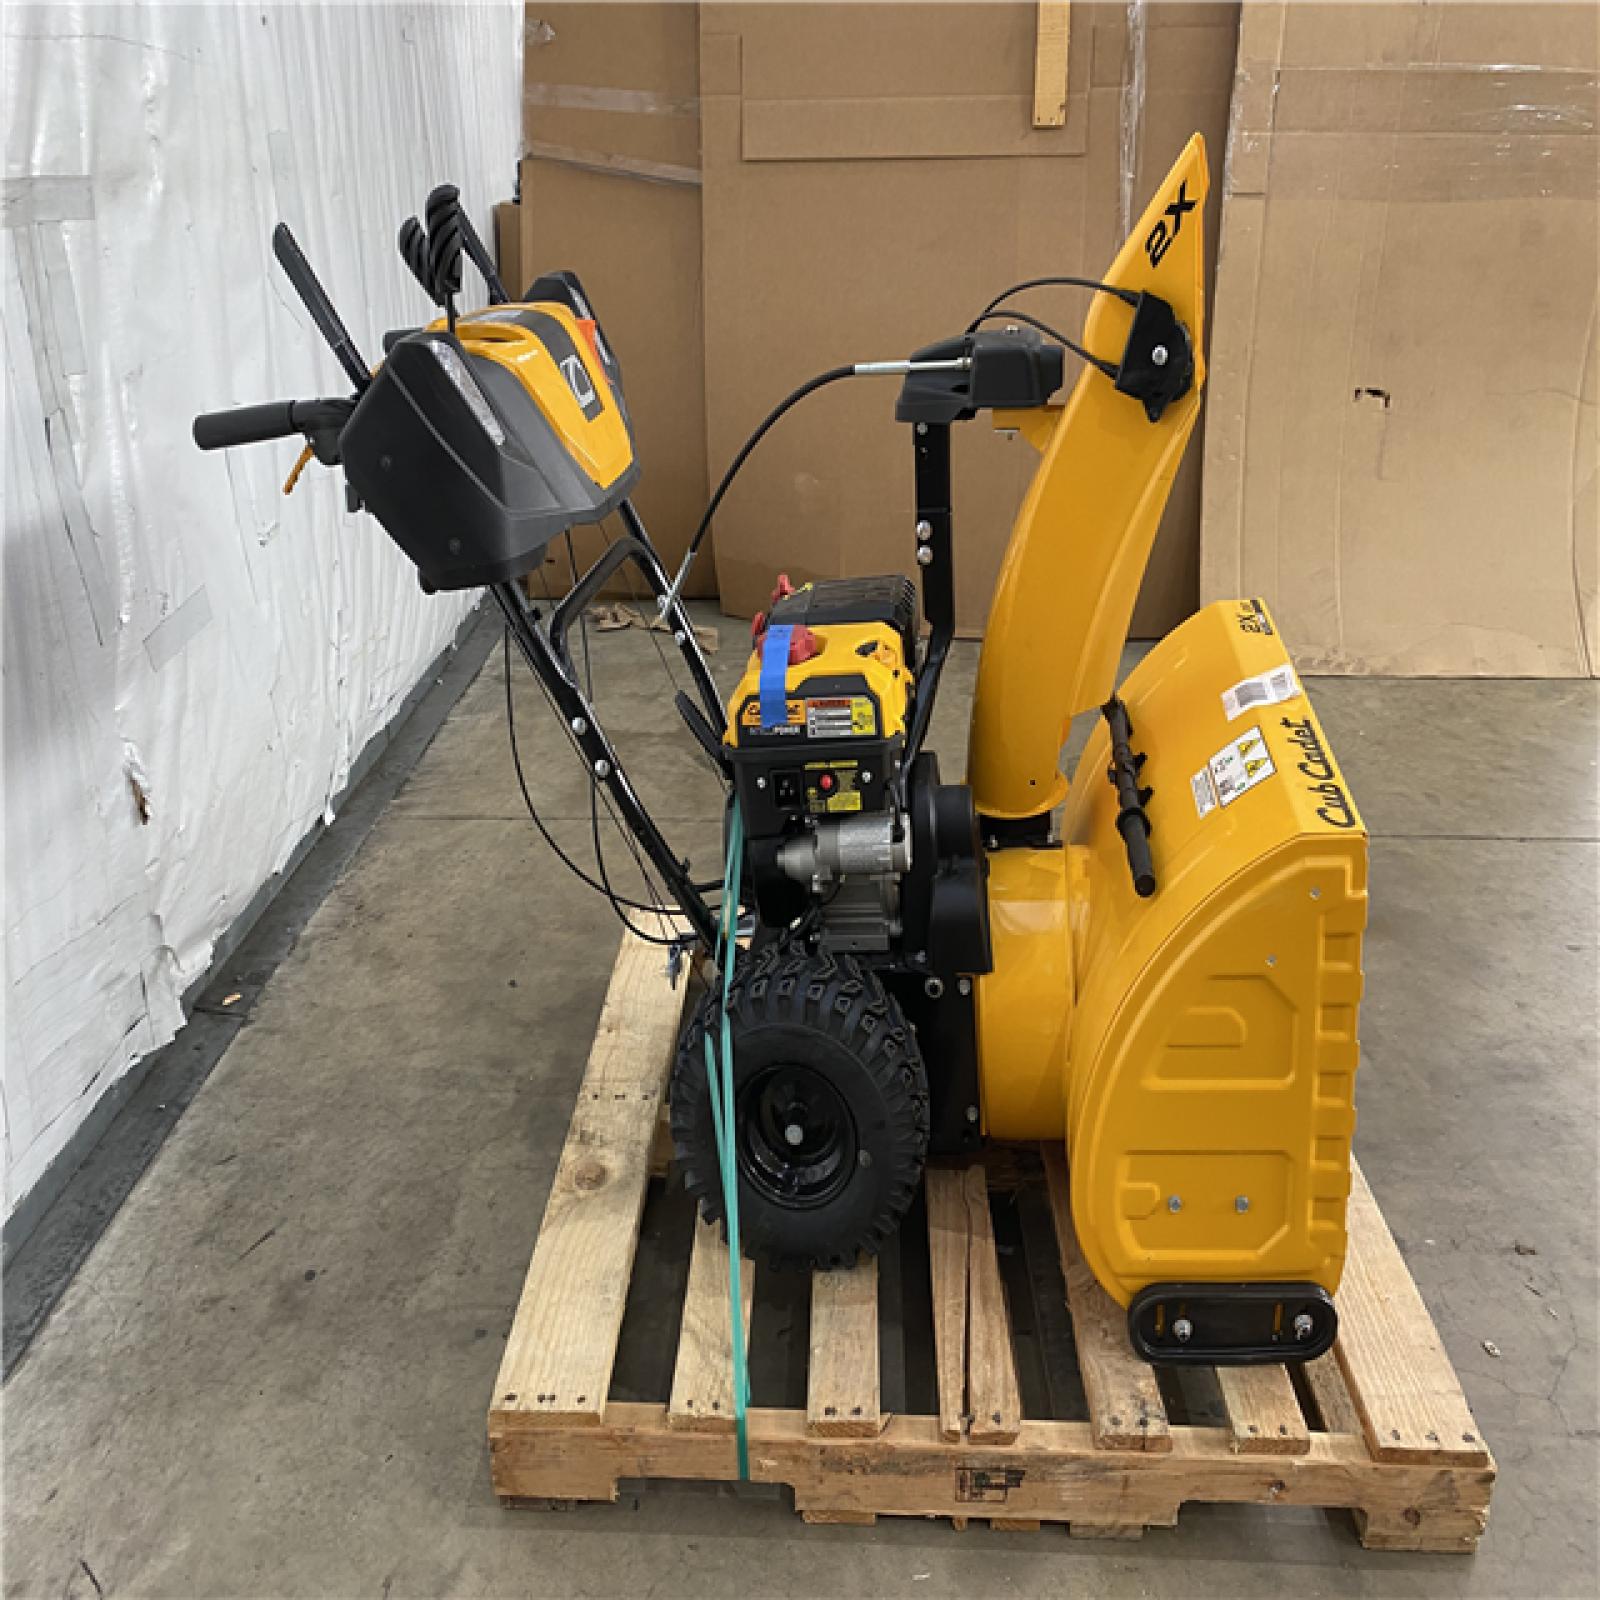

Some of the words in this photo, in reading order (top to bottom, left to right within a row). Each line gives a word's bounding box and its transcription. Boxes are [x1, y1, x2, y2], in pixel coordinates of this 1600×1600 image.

[1145, 180, 1198, 268] 2X
[1280, 717, 1334, 780] Cadet
[1308, 783, 1355, 827] Cub
